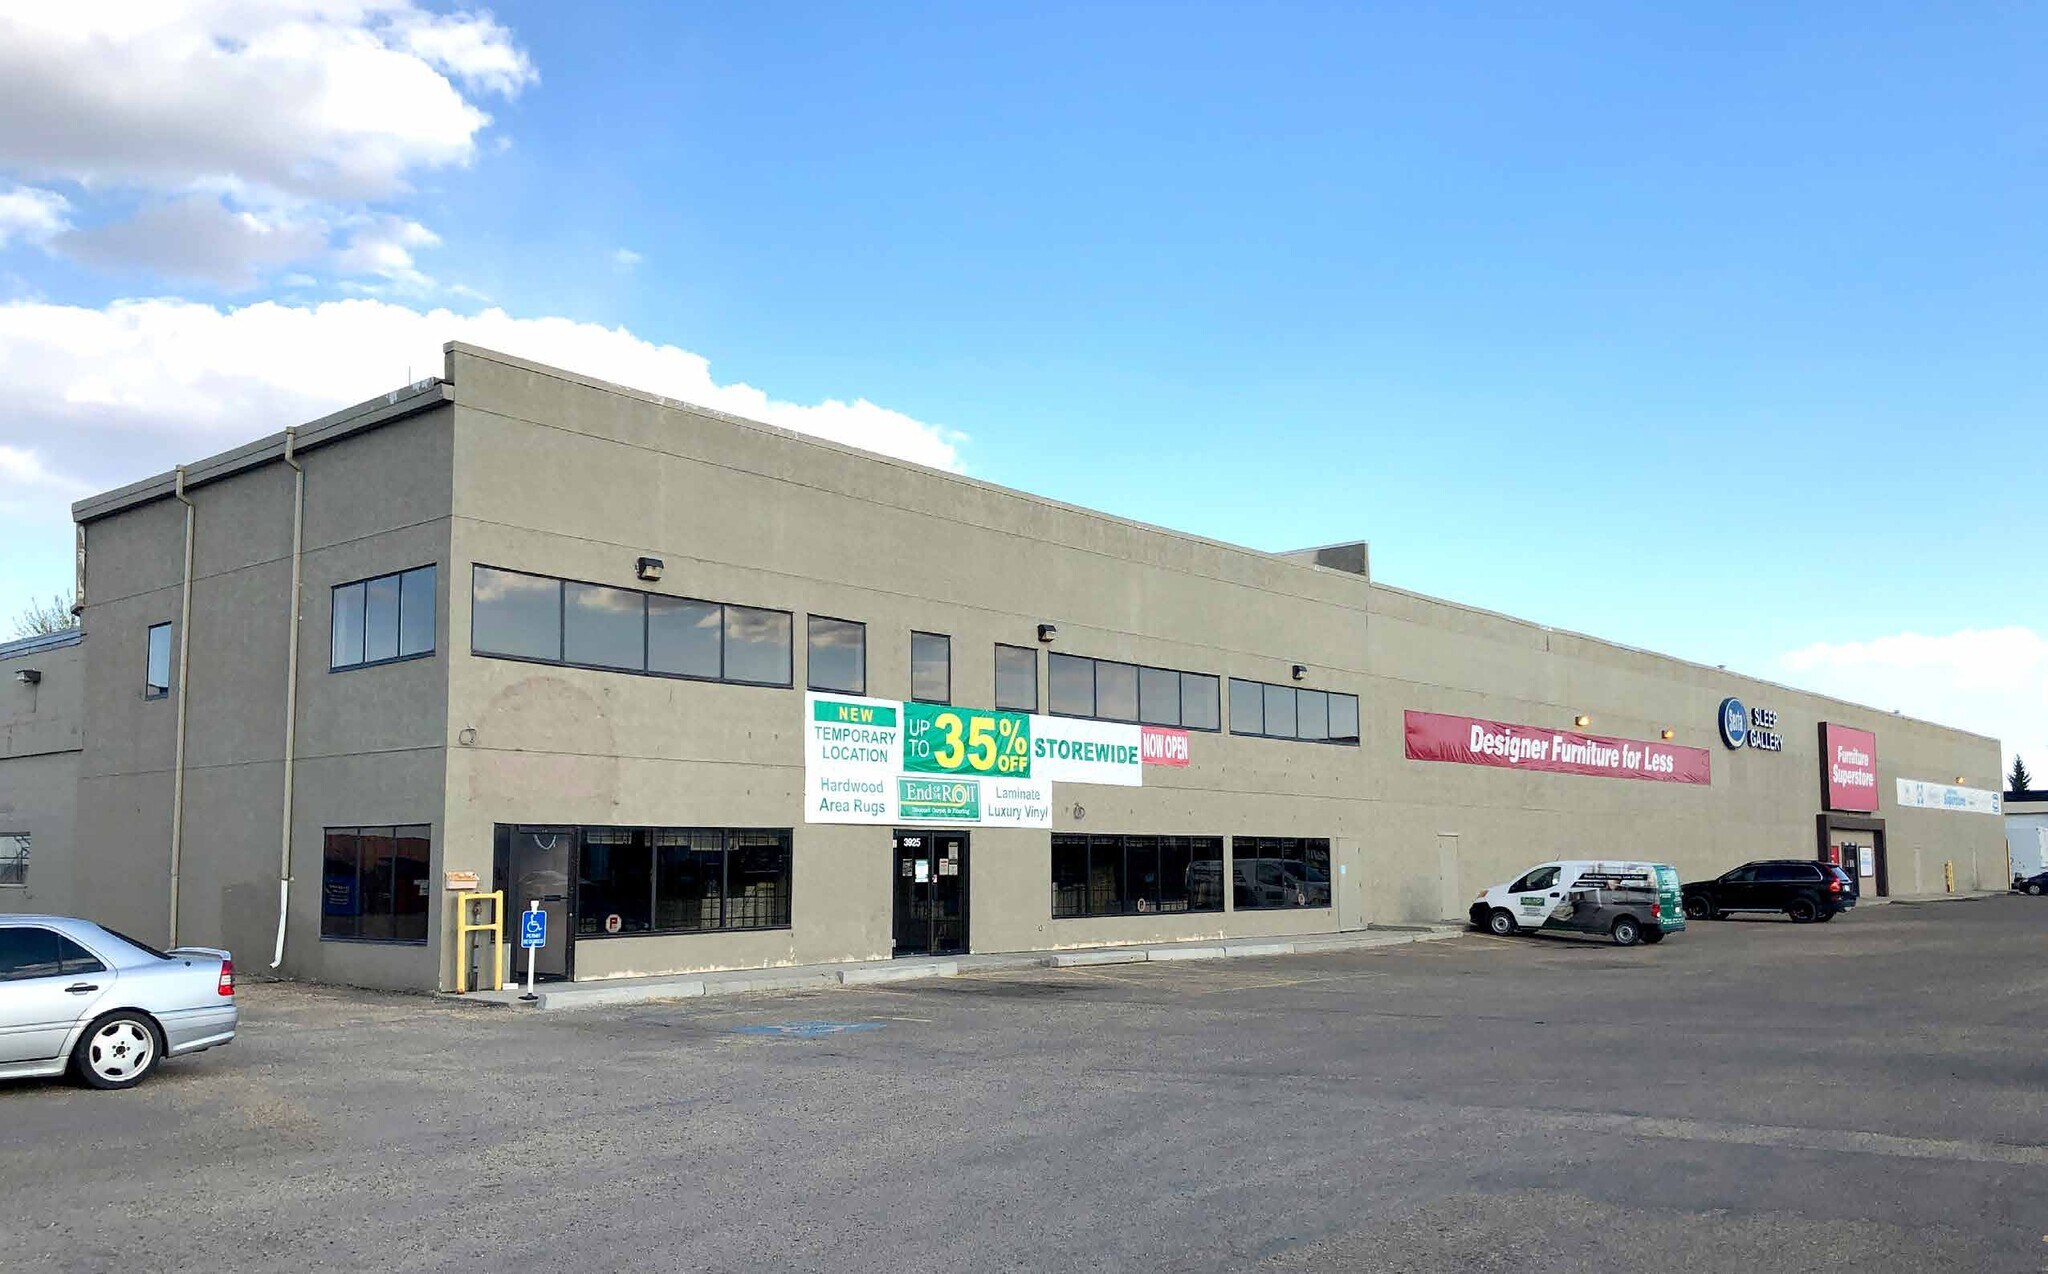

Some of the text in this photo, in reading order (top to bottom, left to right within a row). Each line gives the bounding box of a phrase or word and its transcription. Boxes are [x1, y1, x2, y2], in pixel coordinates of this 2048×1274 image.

[839, 706, 873, 722] NEW
[1728, 709, 1743, 732] Serta
[1752, 707, 1778, 728] SLEEP
[814, 726, 896, 745] TEMPORARY
[909, 719, 930, 736] UP
[908, 738, 930, 757] TO
[934, 713, 1027, 770] 35%
[1143, 733, 1188, 760] NOW OPEN
[1470, 725, 1674, 773] Designer Furniture for Less
[1748, 729, 1783, 751] GALLERY
[822, 745, 888, 763] LOCATION
[1035, 738, 1139, 765] STOREWIDE
[1837, 745, 1869, 767] Furniture
[998, 755, 1028, 772] OFF
[820, 777, 884, 793] Hardwood
[1832, 763, 1874, 788] Superstore
[906, 783, 932, 800] End
[996, 786, 1041, 800] Laminate
[819, 797, 885, 816] Area Rugs
[988, 803, 1048, 821] Luxury Vinyl
[903, 837, 921, 848] 3925
